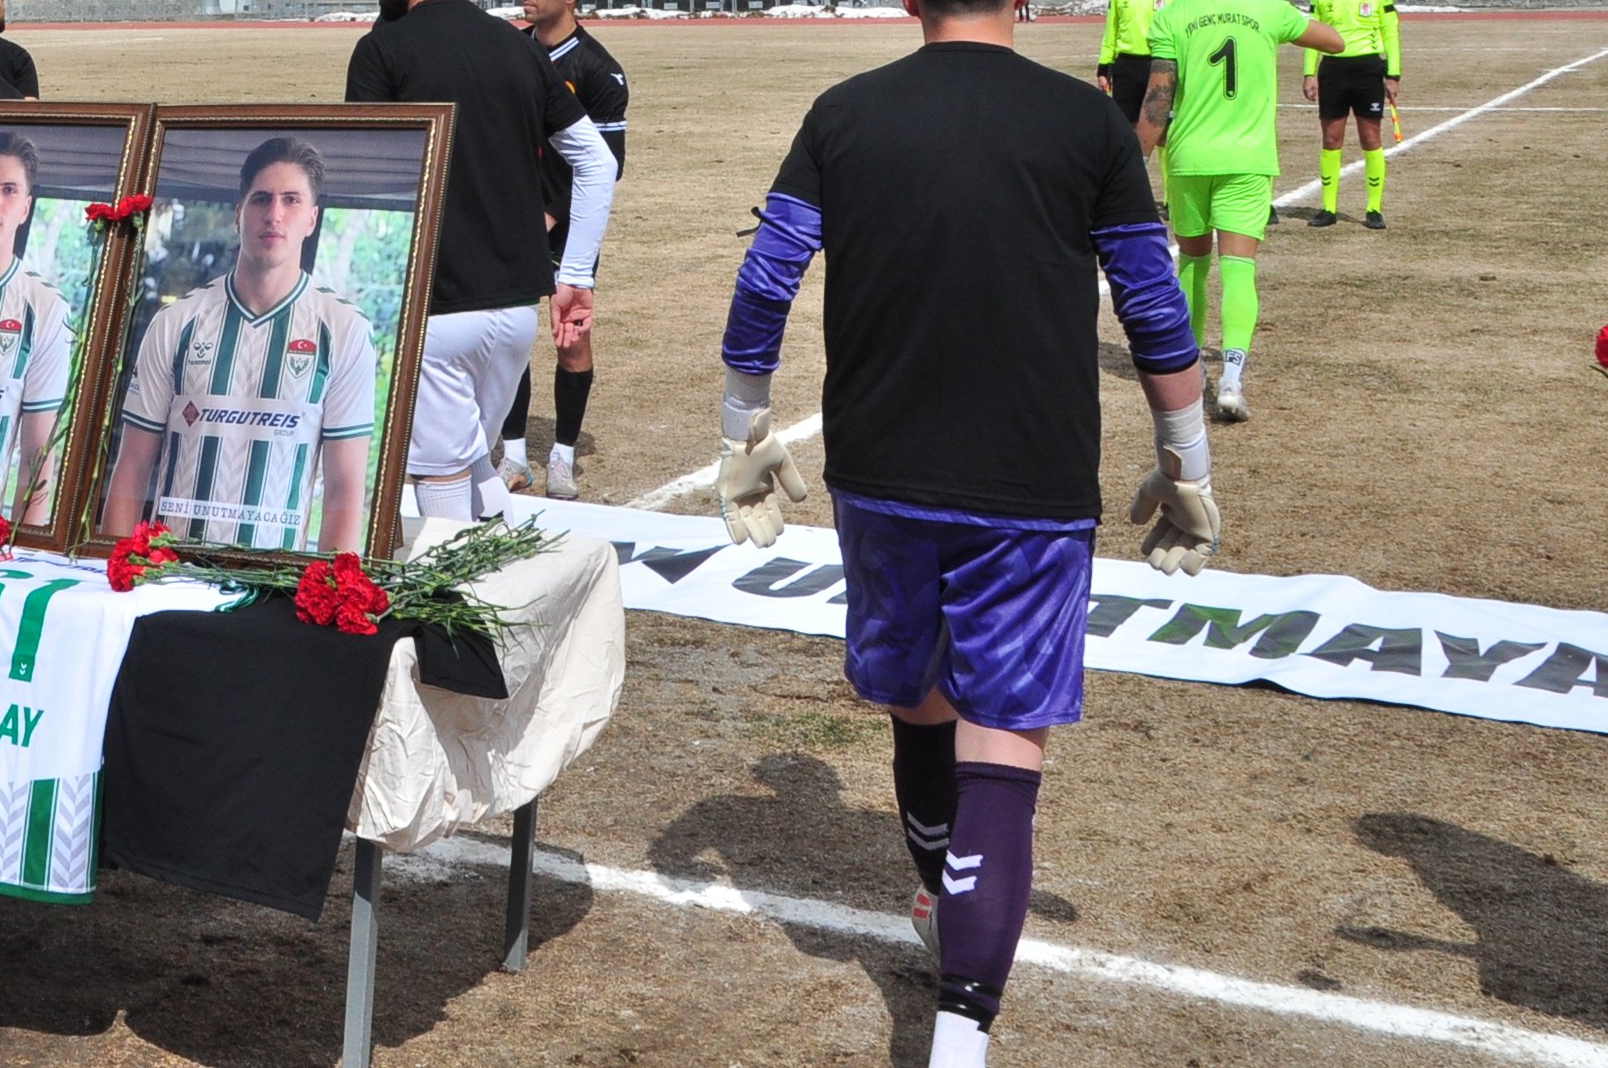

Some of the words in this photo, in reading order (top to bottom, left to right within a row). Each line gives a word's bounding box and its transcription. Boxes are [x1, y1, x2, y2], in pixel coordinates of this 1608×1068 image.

[1207, 35, 1238, 101] 1
[1225, 351, 1242, 365] FS
[199, 408, 301, 428] TURGUTREIS
[160, 501, 190, 514] SENİ
[193, 505, 301, 526] UNUTMAYACAĞIZ
